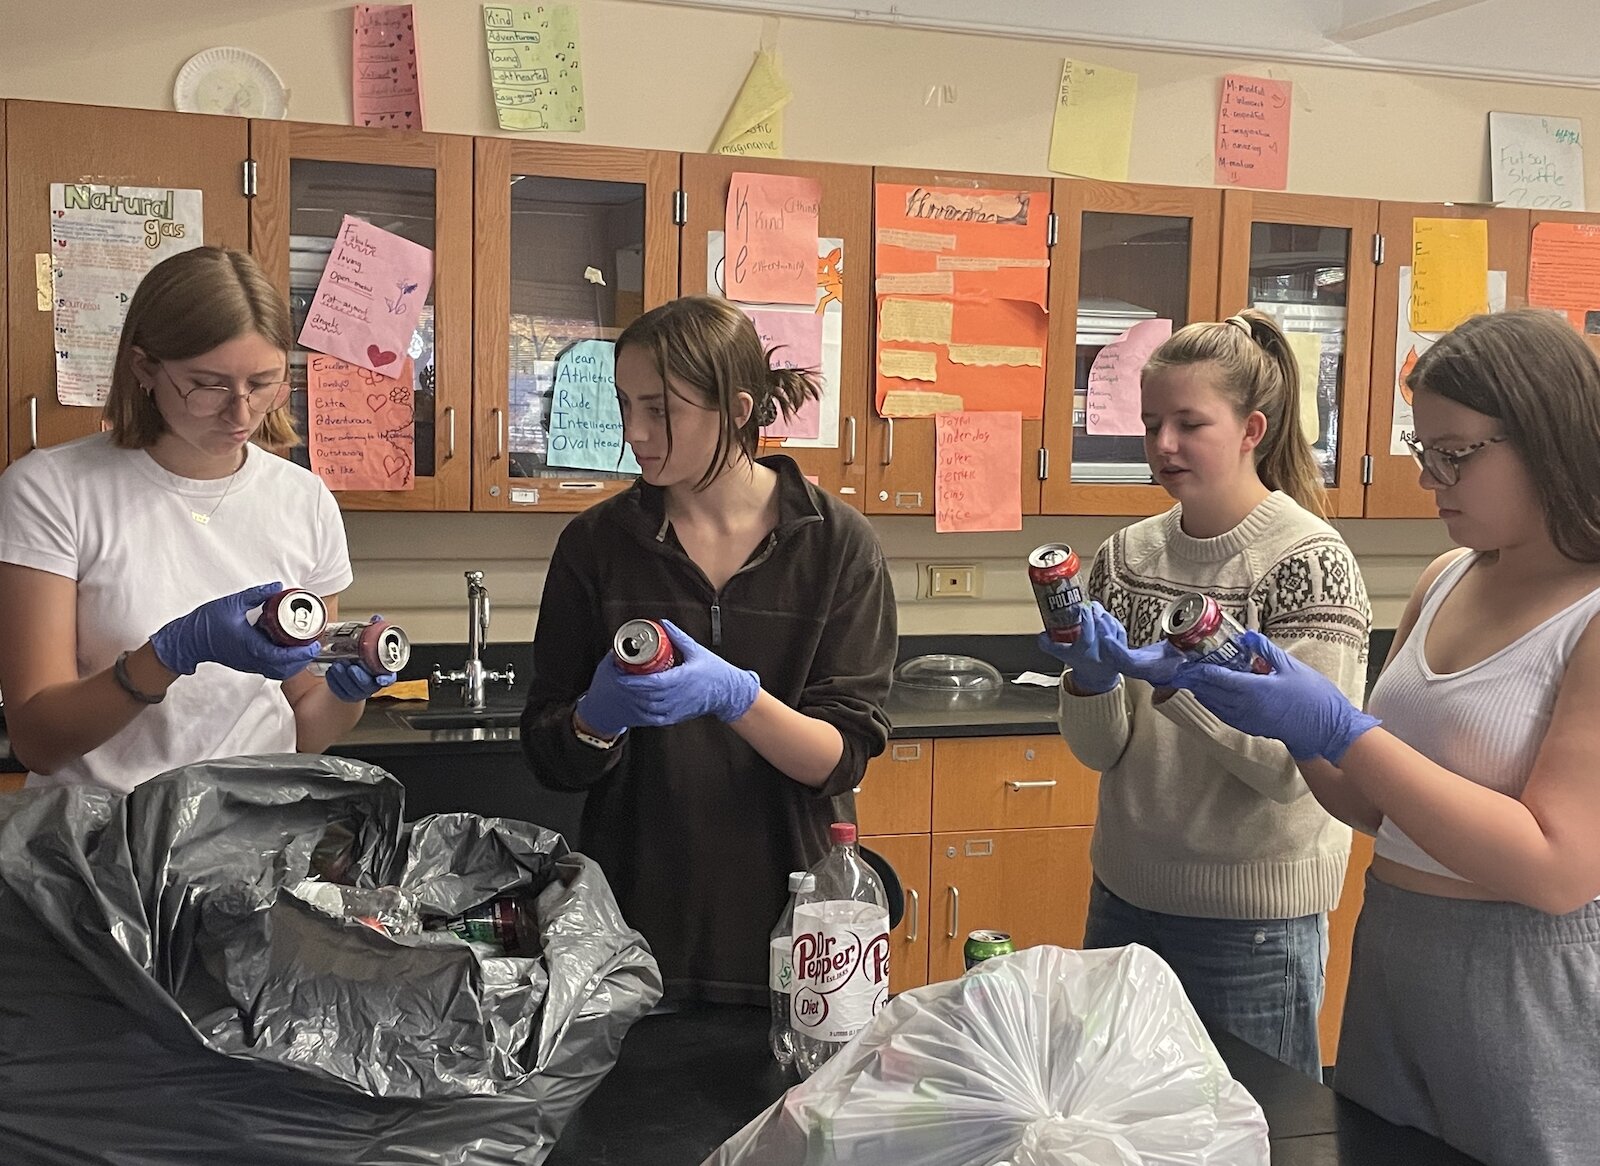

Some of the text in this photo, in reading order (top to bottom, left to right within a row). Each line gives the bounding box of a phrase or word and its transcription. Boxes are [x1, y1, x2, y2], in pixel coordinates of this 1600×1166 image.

[486, 9, 511, 26] Kind
[489, 31, 539, 42] Adventurous
[489, 49, 520, 68] Young
[64, 185, 174, 220] Natural
[145, 219, 185, 250] gas
[558, 362, 615, 384] Athletic
[559, 389, 591, 410] Rude
[553, 411, 623, 433] Intelligent
[552, 435, 620, 451] Oval Head
[1048, 588, 1081, 610] POLAR
[1200, 642, 1239, 664] OLAR
[817, 931, 836, 957] Dr
[793, 933, 856, 985] Pepper
[801, 999, 820, 1015] Diet
